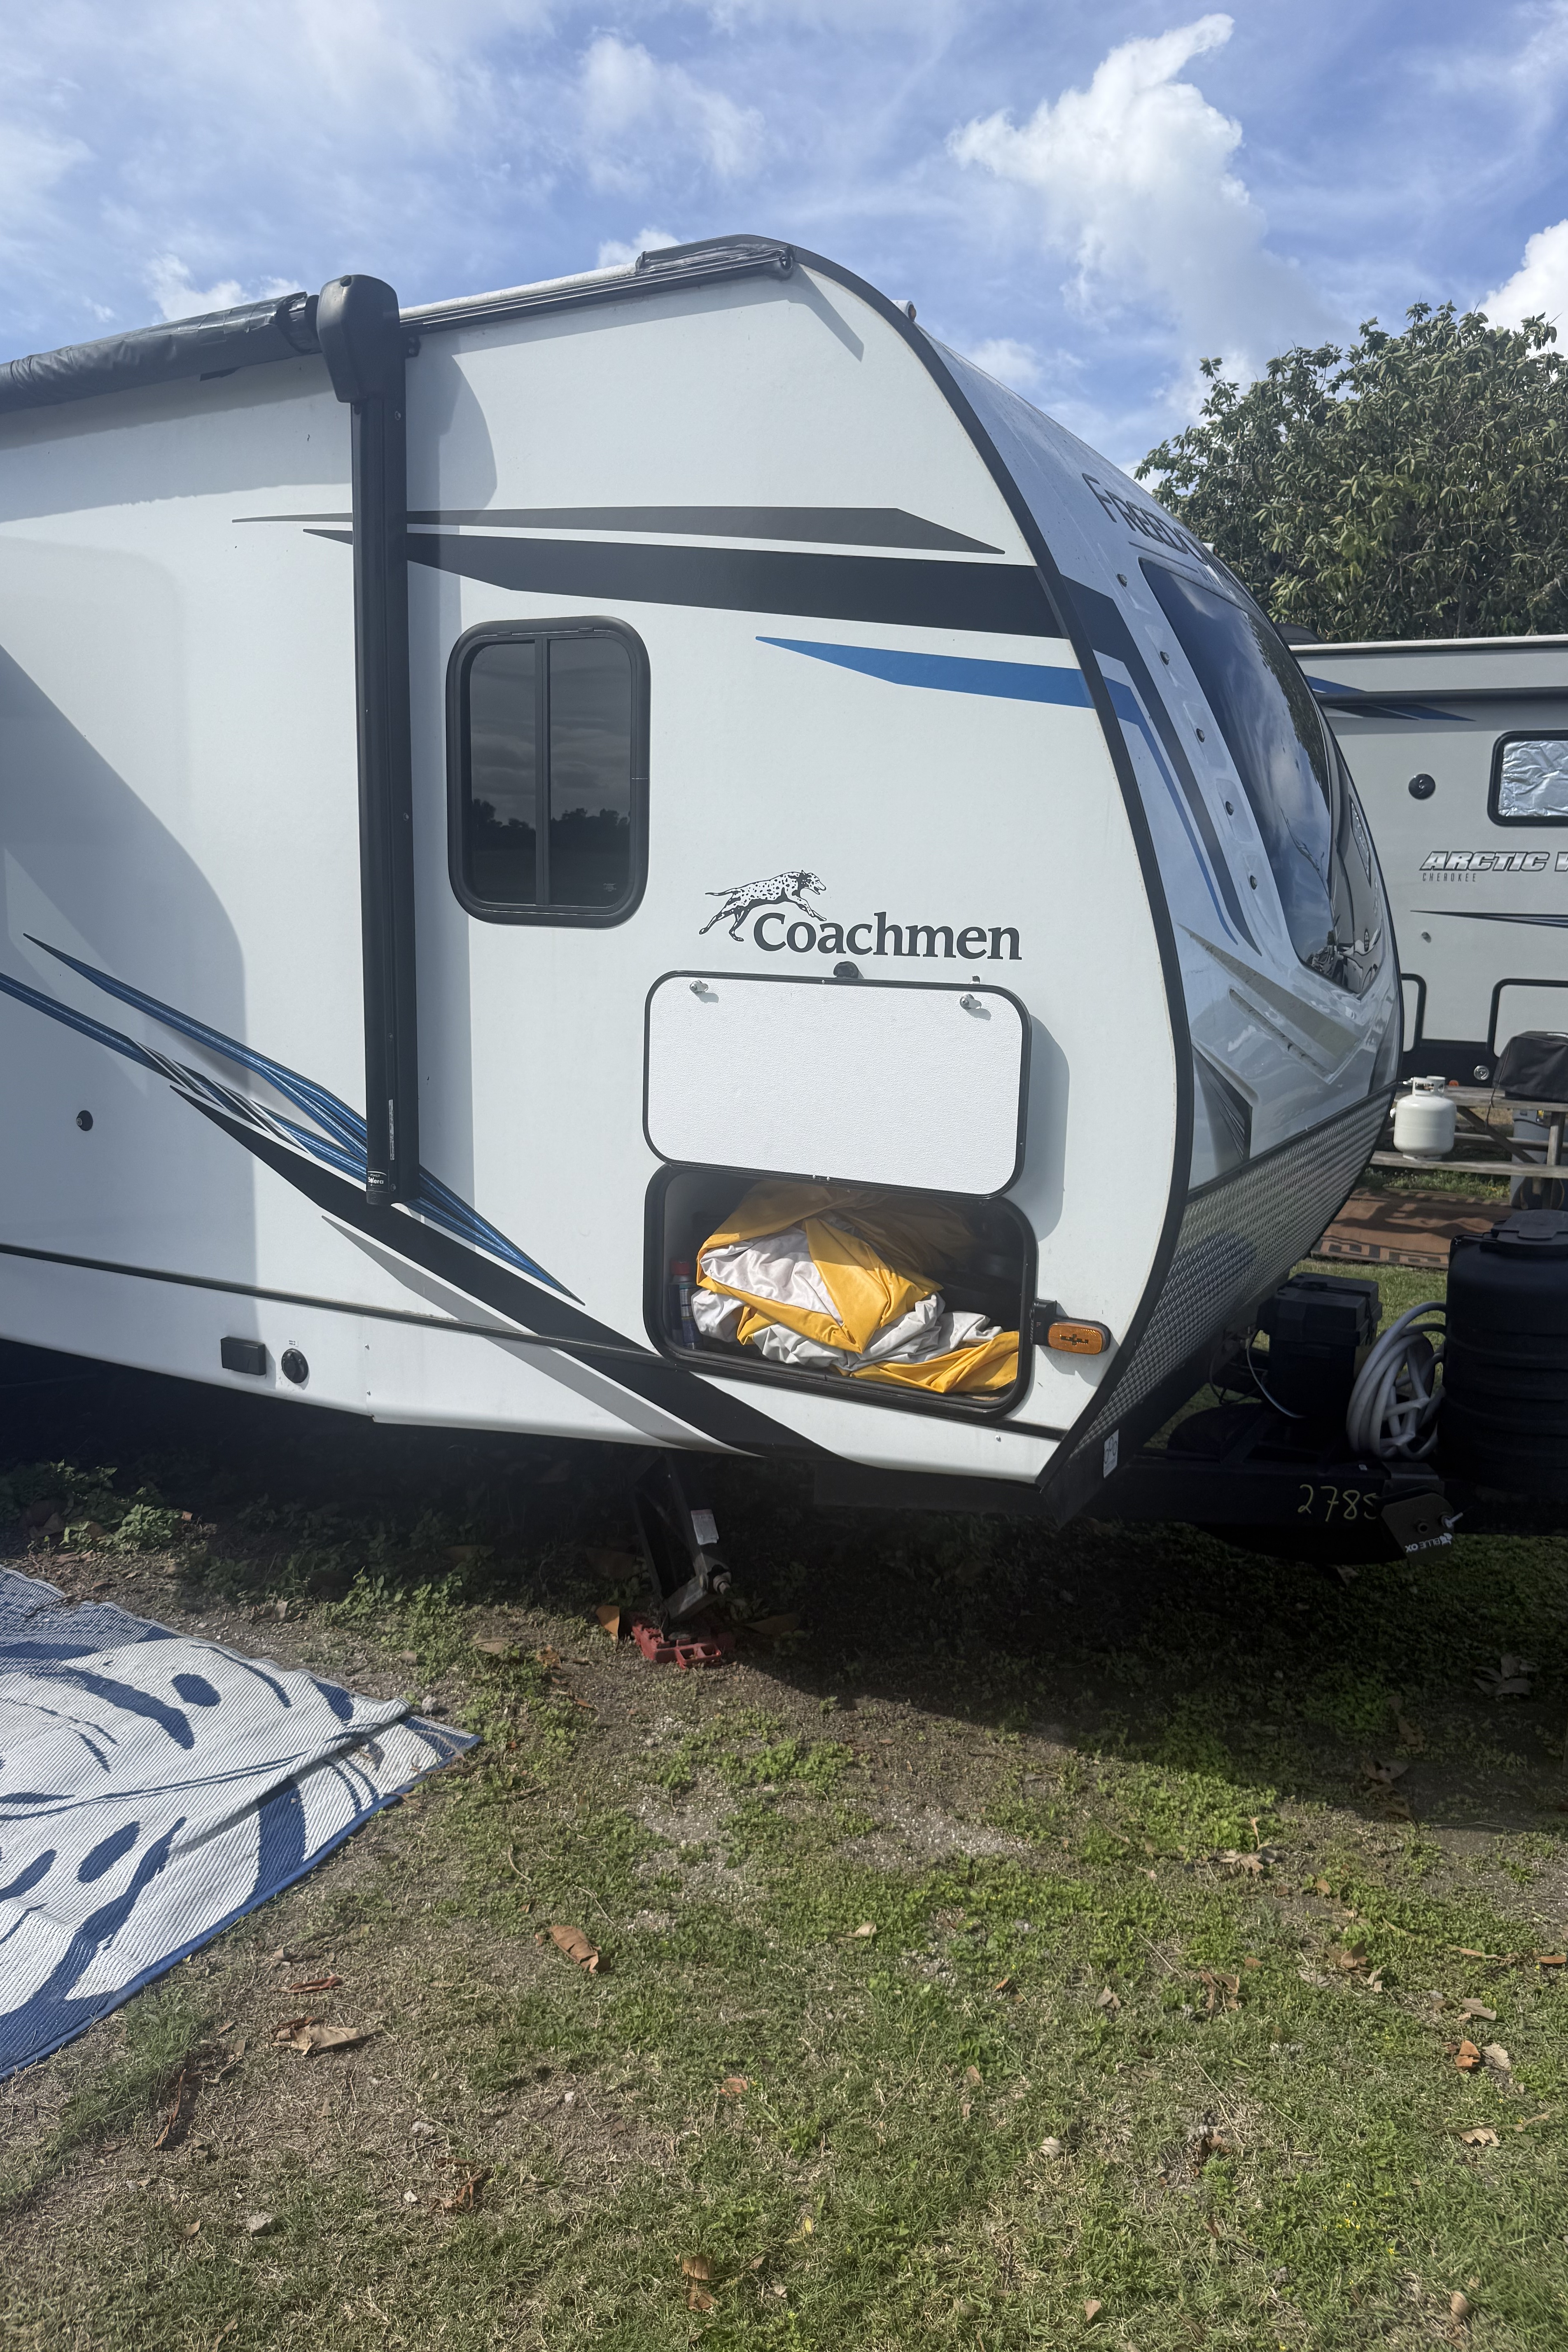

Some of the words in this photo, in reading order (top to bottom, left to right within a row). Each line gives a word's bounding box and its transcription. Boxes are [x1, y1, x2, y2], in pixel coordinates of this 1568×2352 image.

[1419, 851, 1550, 872] ARCTIC
[1422, 873, 1477, 882] CHEROKEE
[754, 911, 1022, 960] Coachmen
[1405, 1543, 1419, 1552] OX
[1419, 1538, 1440, 1549] BLUE
